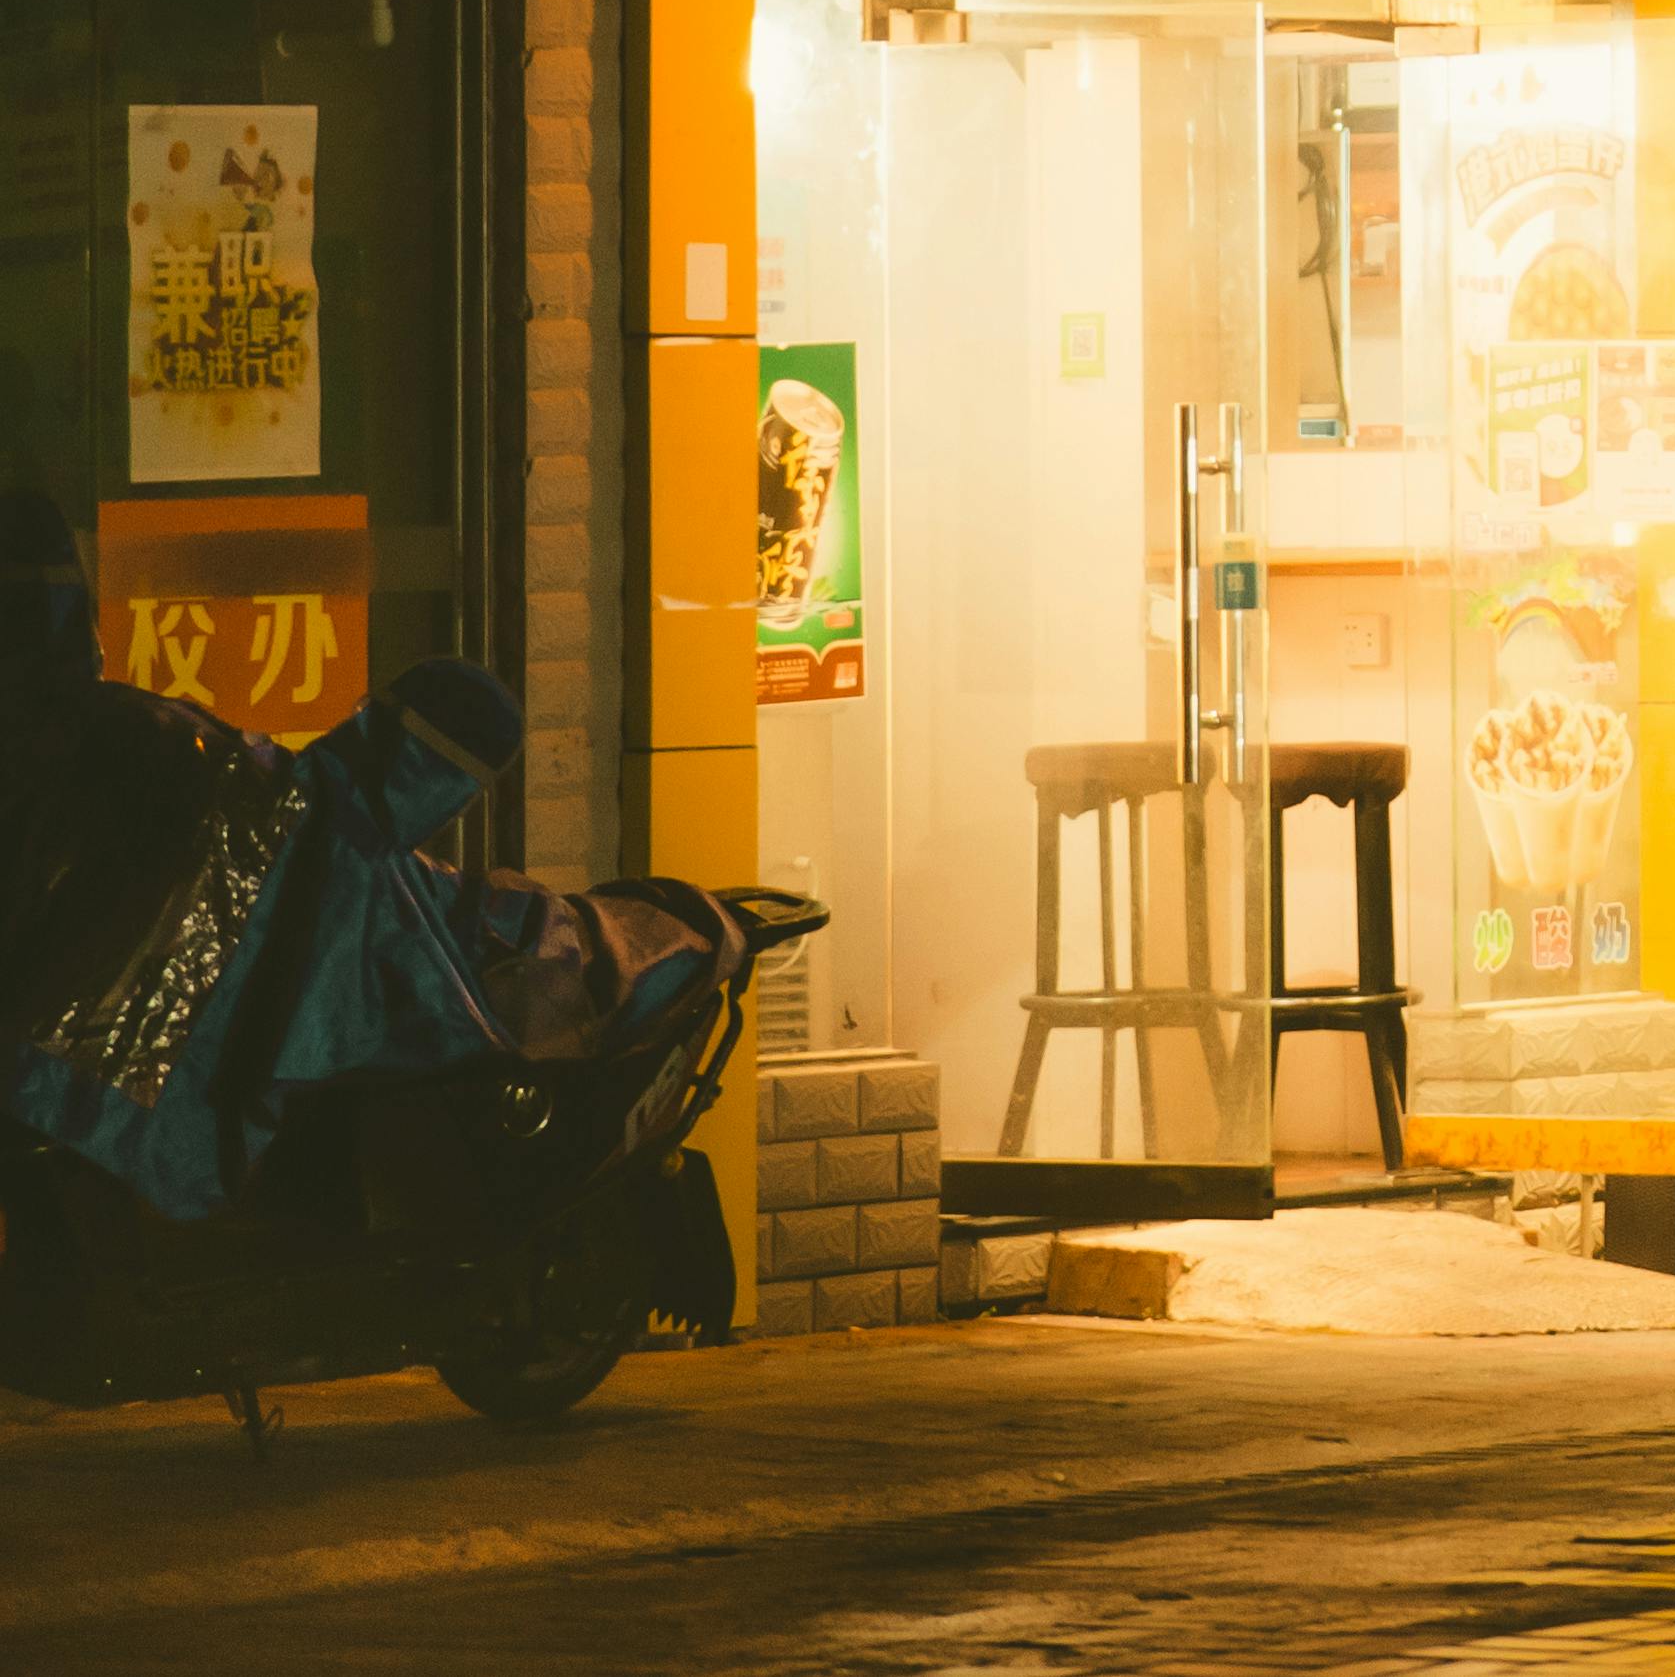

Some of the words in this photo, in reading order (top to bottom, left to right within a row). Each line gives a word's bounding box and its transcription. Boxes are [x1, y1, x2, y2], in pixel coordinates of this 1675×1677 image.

[149, 231, 282, 344] 兼职
[220, 307, 282, 348] 招聘
[1474, 902, 1630, 973] 炒酸奶
